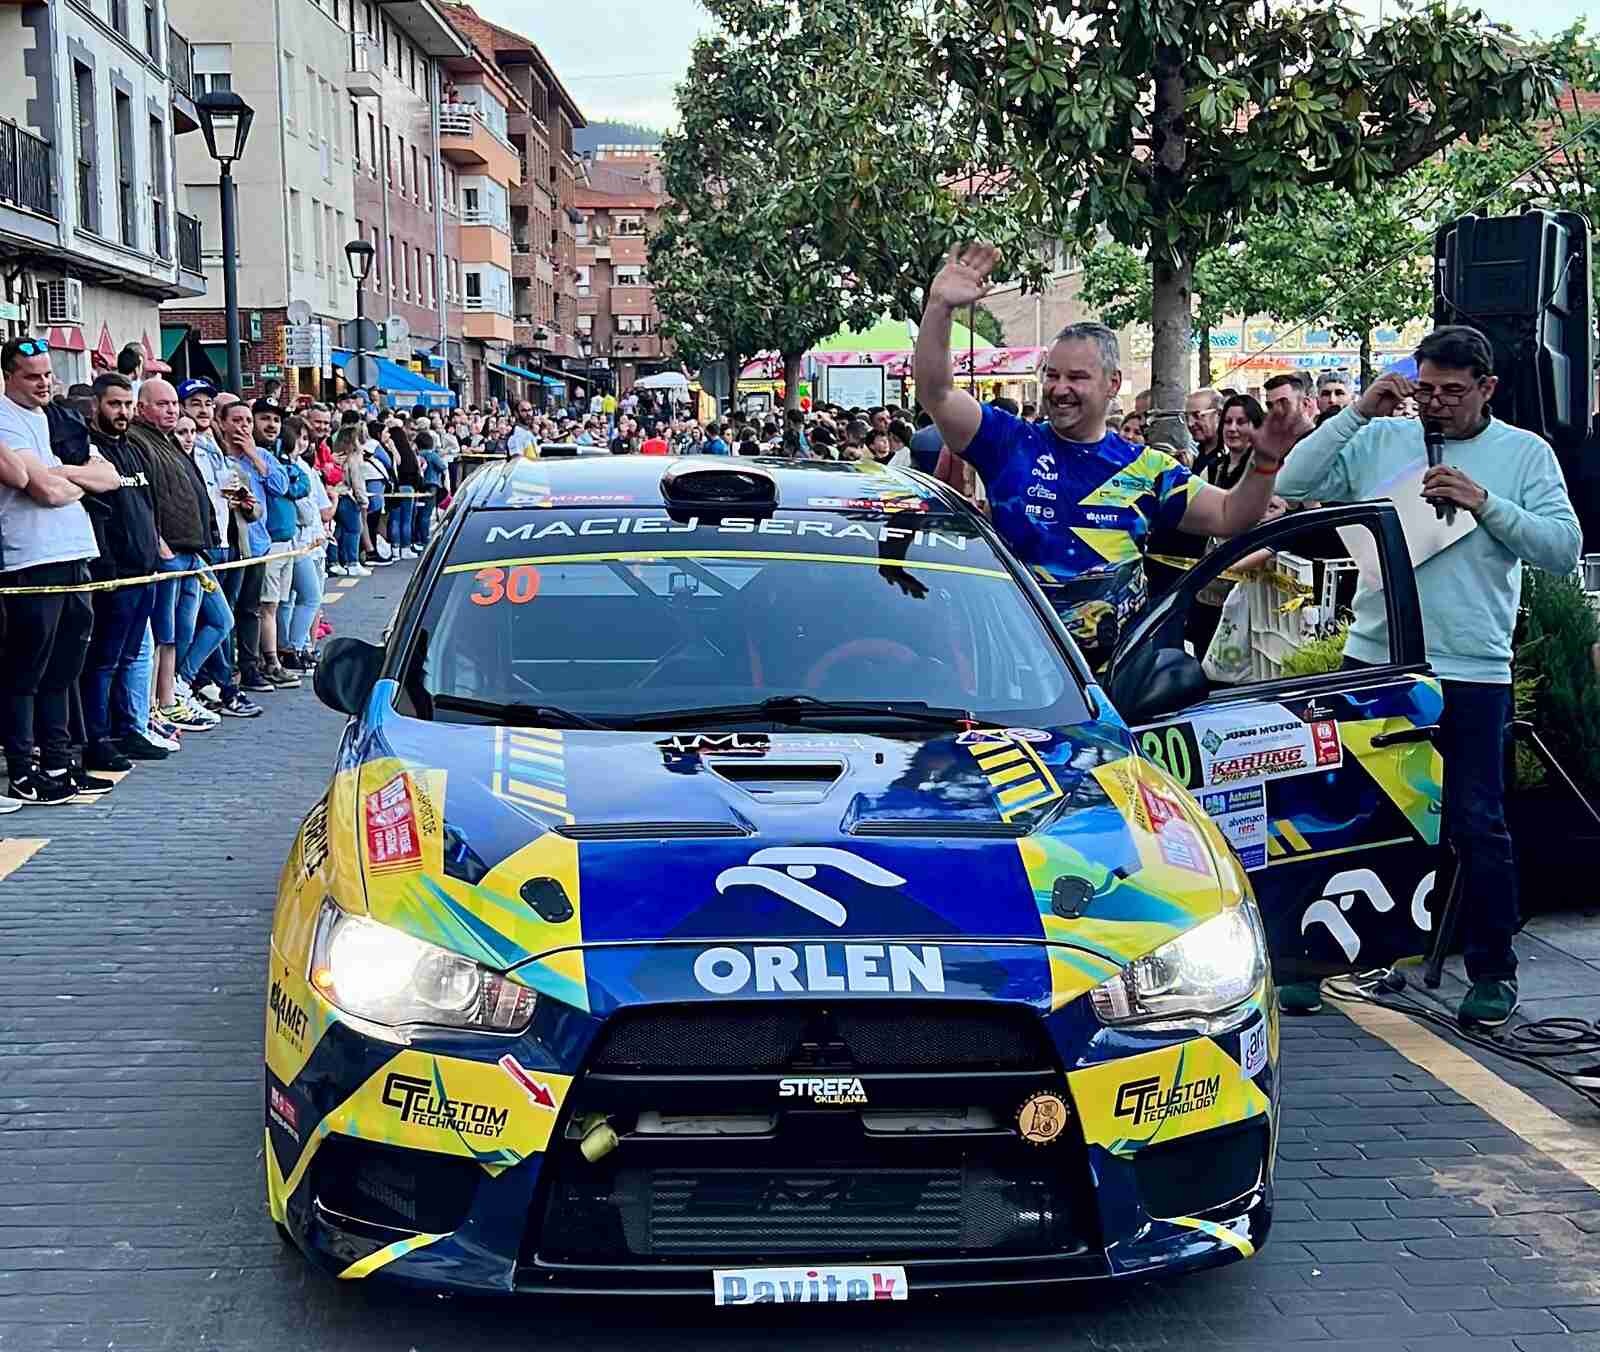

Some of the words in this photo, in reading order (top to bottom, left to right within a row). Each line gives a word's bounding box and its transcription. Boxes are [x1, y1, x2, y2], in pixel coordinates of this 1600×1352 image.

[485, 516, 700, 544] MACIEJ
[717, 517, 968, 551] SERAFIN
[470, 566, 541, 606] 30
[1259, 721, 1303, 736] MOTOR
[1142, 727, 1192, 788] 30
[1211, 749, 1302, 776] KARTING
[694, 944, 946, 994] ORLEN
[779, 1078, 865, 1096] STREFA
[1144, 1074, 1220, 1110] CUSTOM
[411, 1111, 504, 1137] TECHNOLOGY
[413, 1094, 509, 1127] CUSTOM
[1143, 1093, 1218, 1122] TECHNOLOGY
[722, 1271, 897, 1304] Pavitek
